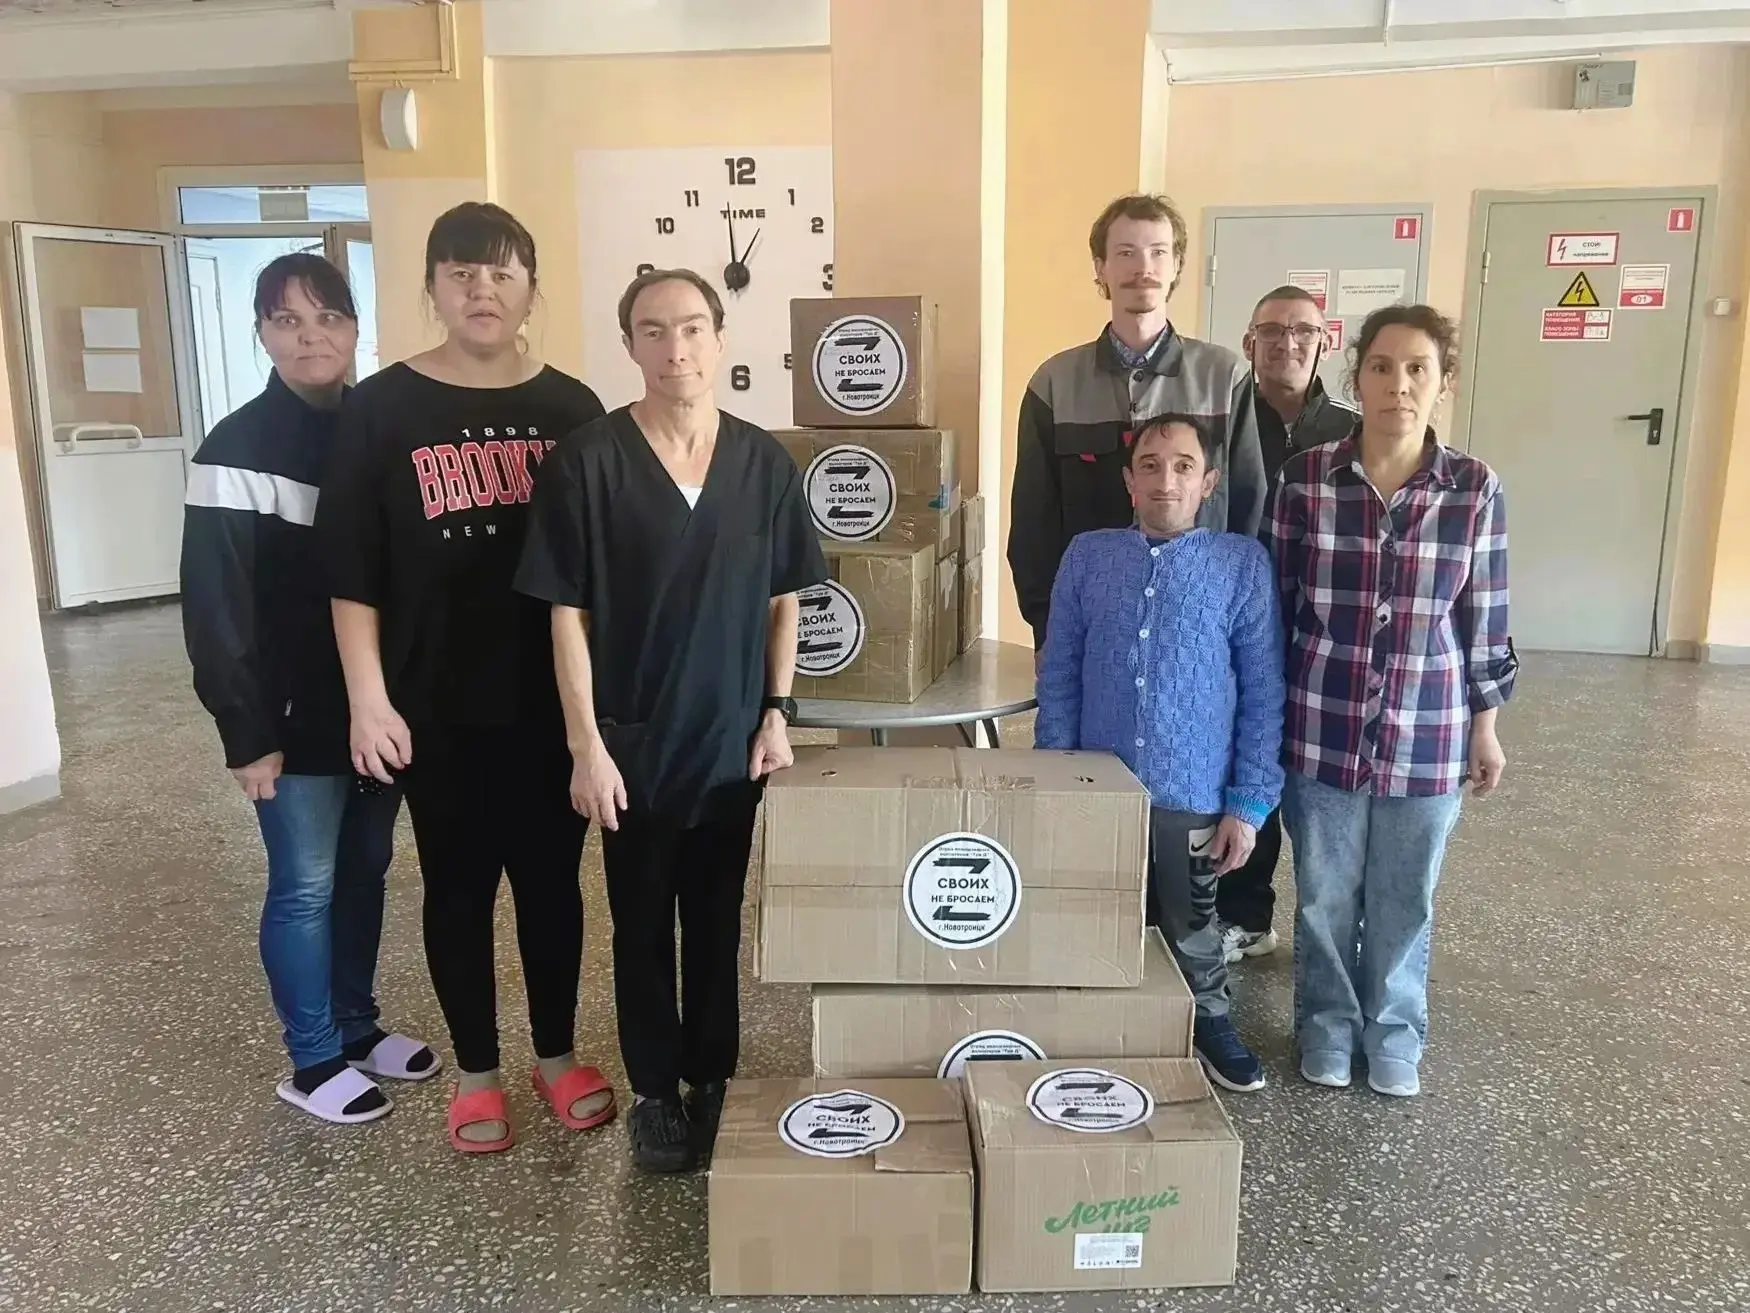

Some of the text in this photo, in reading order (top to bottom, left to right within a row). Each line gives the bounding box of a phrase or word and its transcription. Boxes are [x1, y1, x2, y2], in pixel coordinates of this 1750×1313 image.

[724, 157, 756, 186] 12
[684, 190, 700, 207] 11
[788, 188, 796, 206] 1
[720, 208, 766, 220] TIME
[655, 217, 675, 234] 10
[811, 216, 825, 234] 2
[839, 353, 881, 365] СВОИХ
[731, 365, 750, 391] 6
[847, 368, 886, 377] БРОСАЕМ
[461, 426, 539, 438] 1898
[411, 440, 557, 520] BROOK
[829, 482, 870, 493] СВОИХ
[442, 524, 496, 540] NEW
[804, 626, 843, 638] БРОСАЕМ
[937, 878, 989, 889] СВОИХ
[931, 895, 995, 903] НЕ БРОСАЕМ
[816, 1114, 870, 1124] СВОИХ
[1044, 1184, 1180, 1233] Летний
